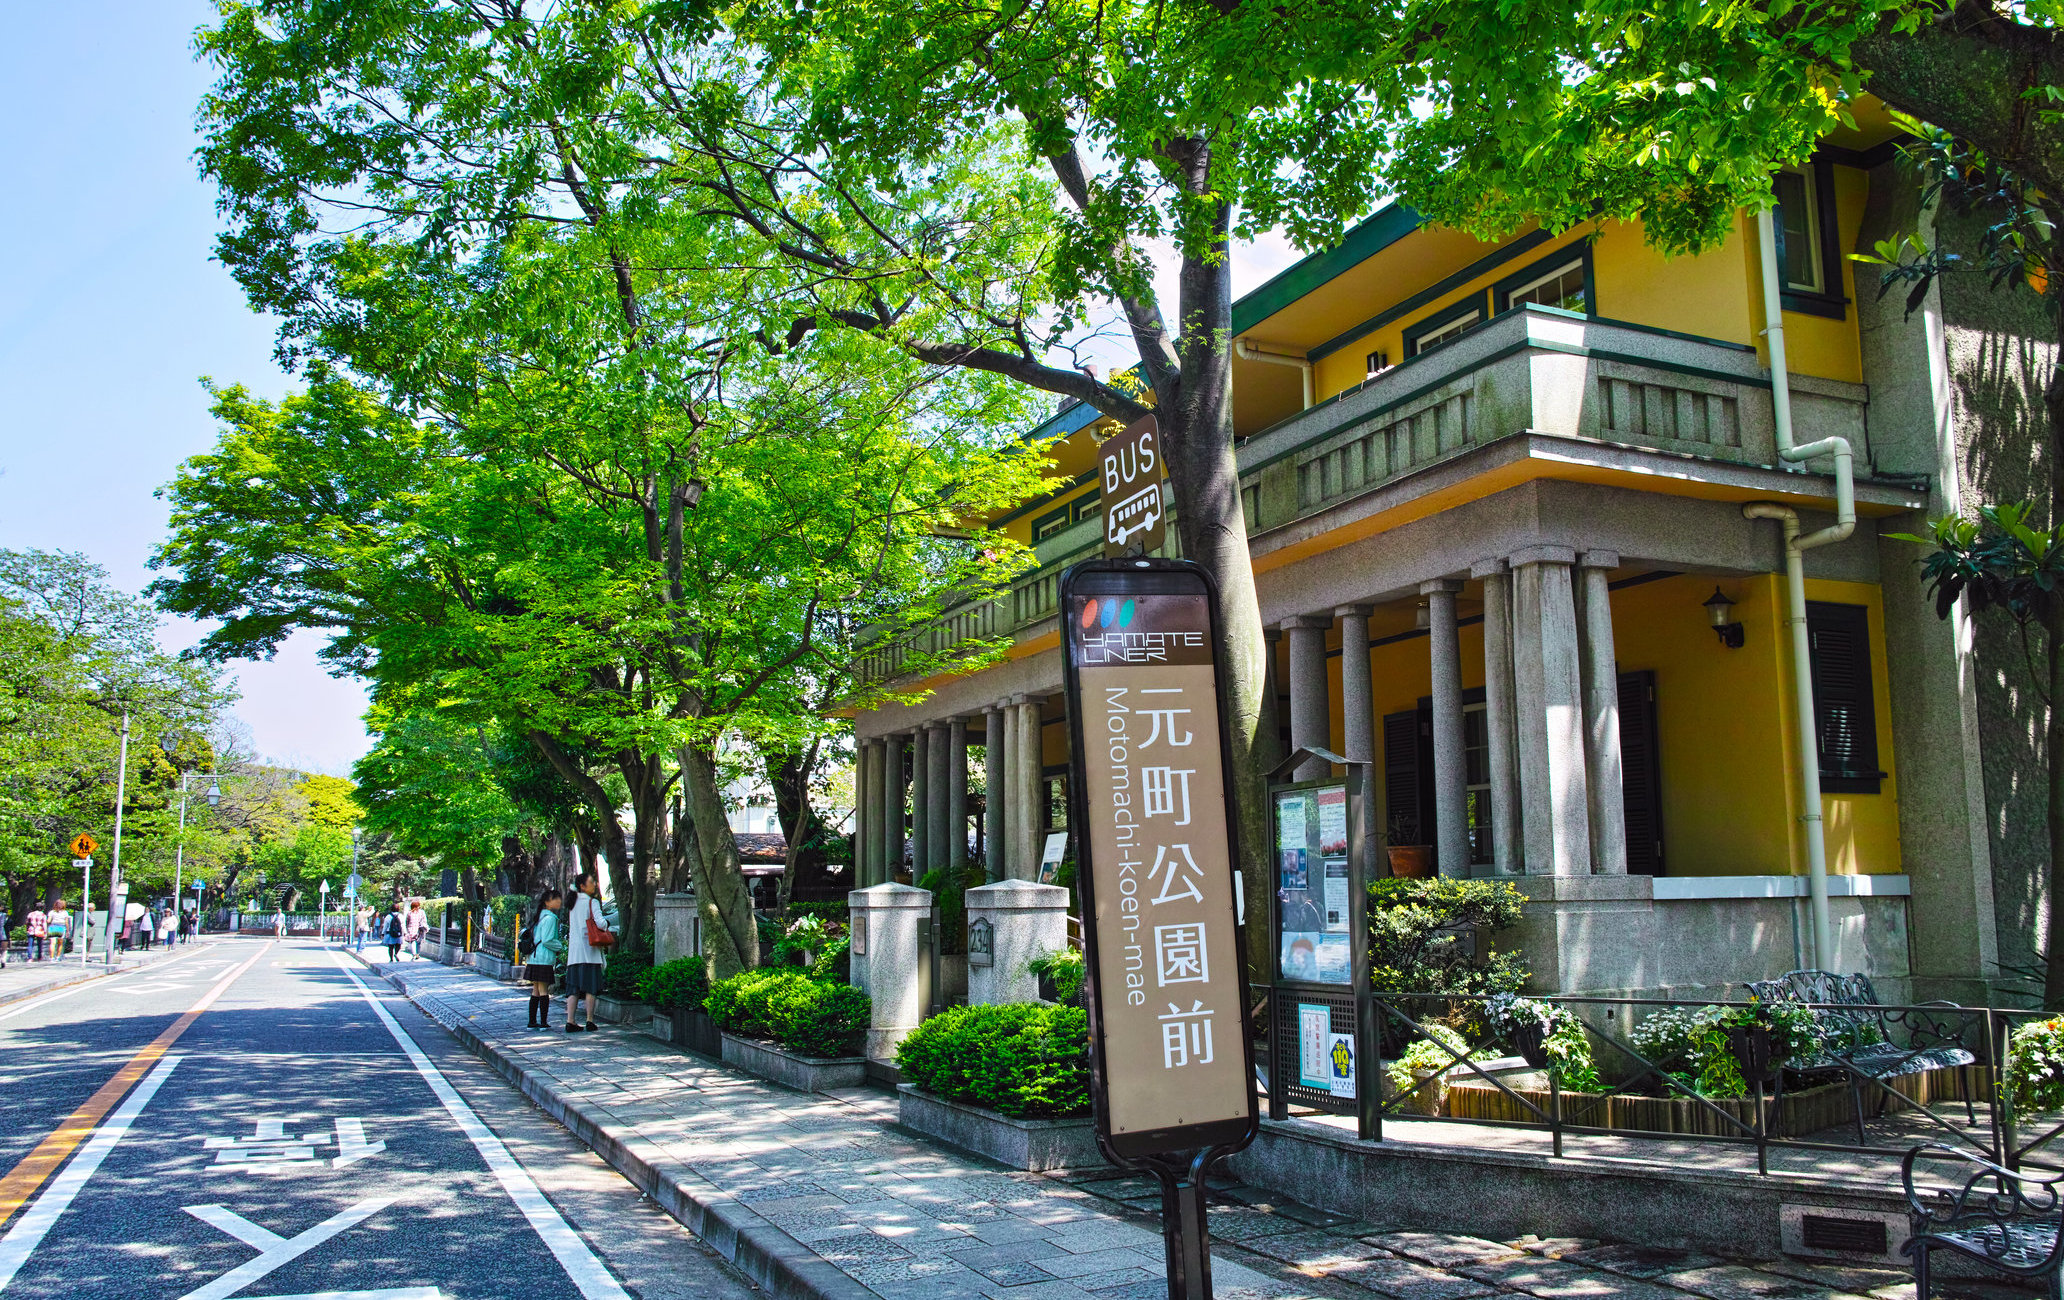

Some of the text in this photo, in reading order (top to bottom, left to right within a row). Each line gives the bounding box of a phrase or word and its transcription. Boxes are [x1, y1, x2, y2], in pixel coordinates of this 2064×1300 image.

[1105, 432, 1155, 494] BUS
[1083, 632, 1204, 647] YAMATE
[1084, 648, 1168, 662] LINER
[1105, 687, 1146, 1007] Motomachi-koen-mae
[1135, 688, 1215, 1069] 元町公園前
[971, 928, 988, 953] 234
